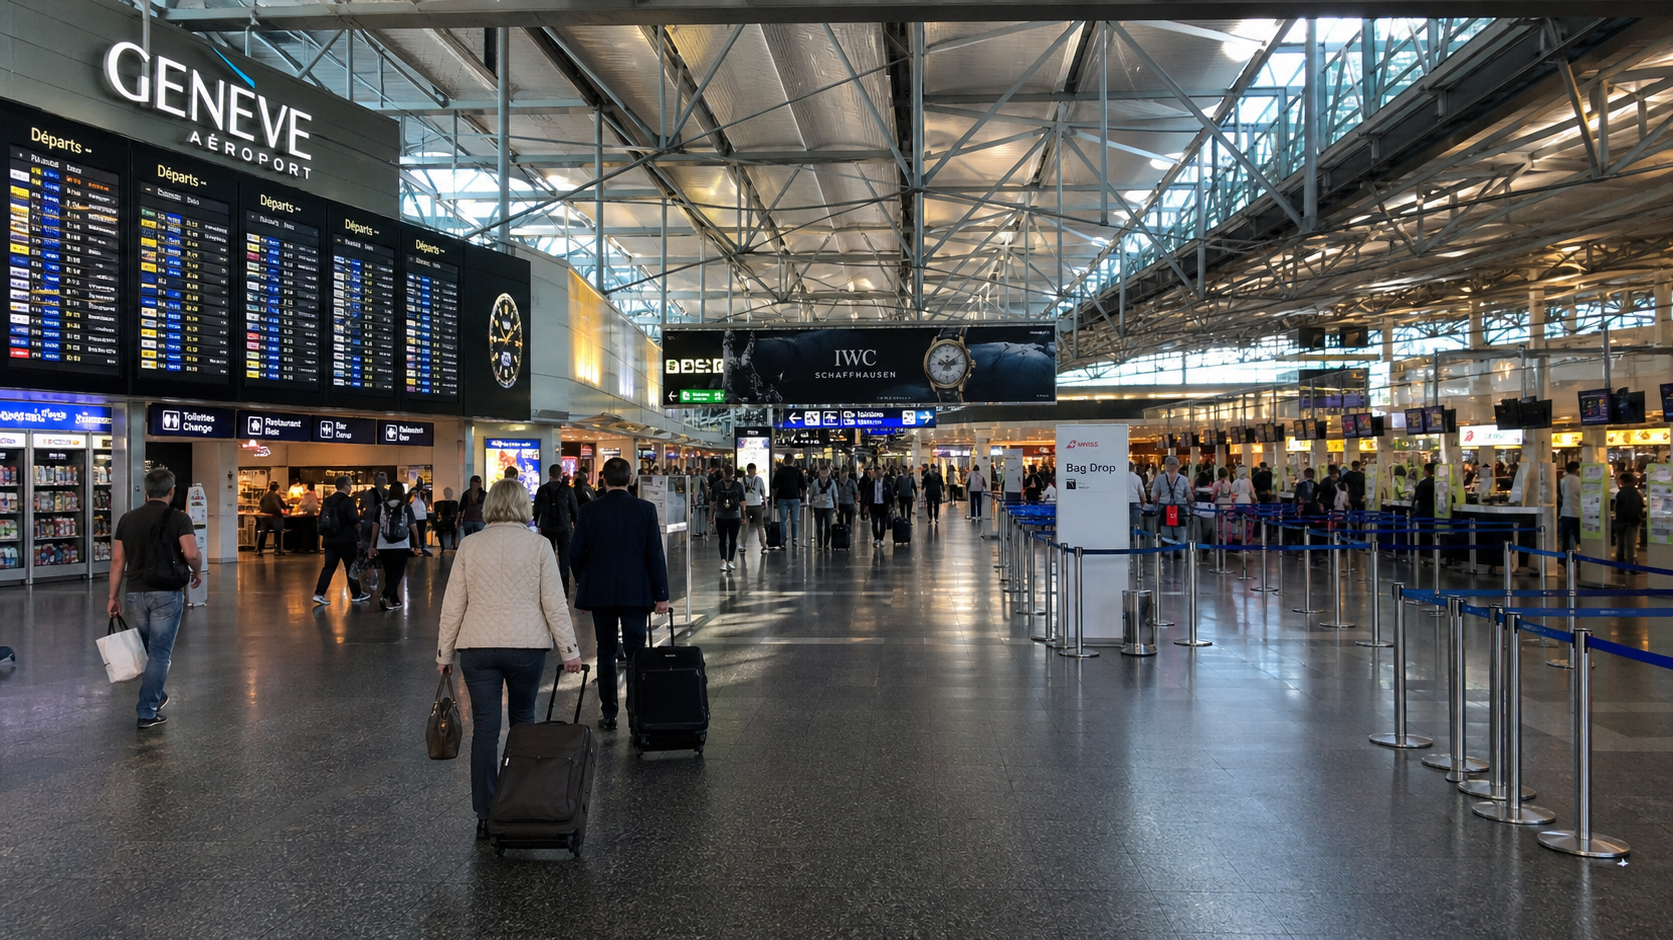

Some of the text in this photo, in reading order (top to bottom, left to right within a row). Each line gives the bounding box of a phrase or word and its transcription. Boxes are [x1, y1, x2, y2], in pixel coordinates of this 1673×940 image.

[31, 127, 82, 154] Départs
[188, 130, 312, 180] AÉROPORT
[157, 164, 199, 187] Départs
[260, 193, 294, 213] Départs
[345, 218, 373, 236] Départs
[415, 239, 440, 255] Départs
[834, 348, 877, 367] IWC
[815, 371, 896, 379] SCHAFFHAUSEN
[183, 412, 215, 423] Toilettes
[183, 422, 213, 434] Change
[1066, 463, 1116, 475] Bag Drop
